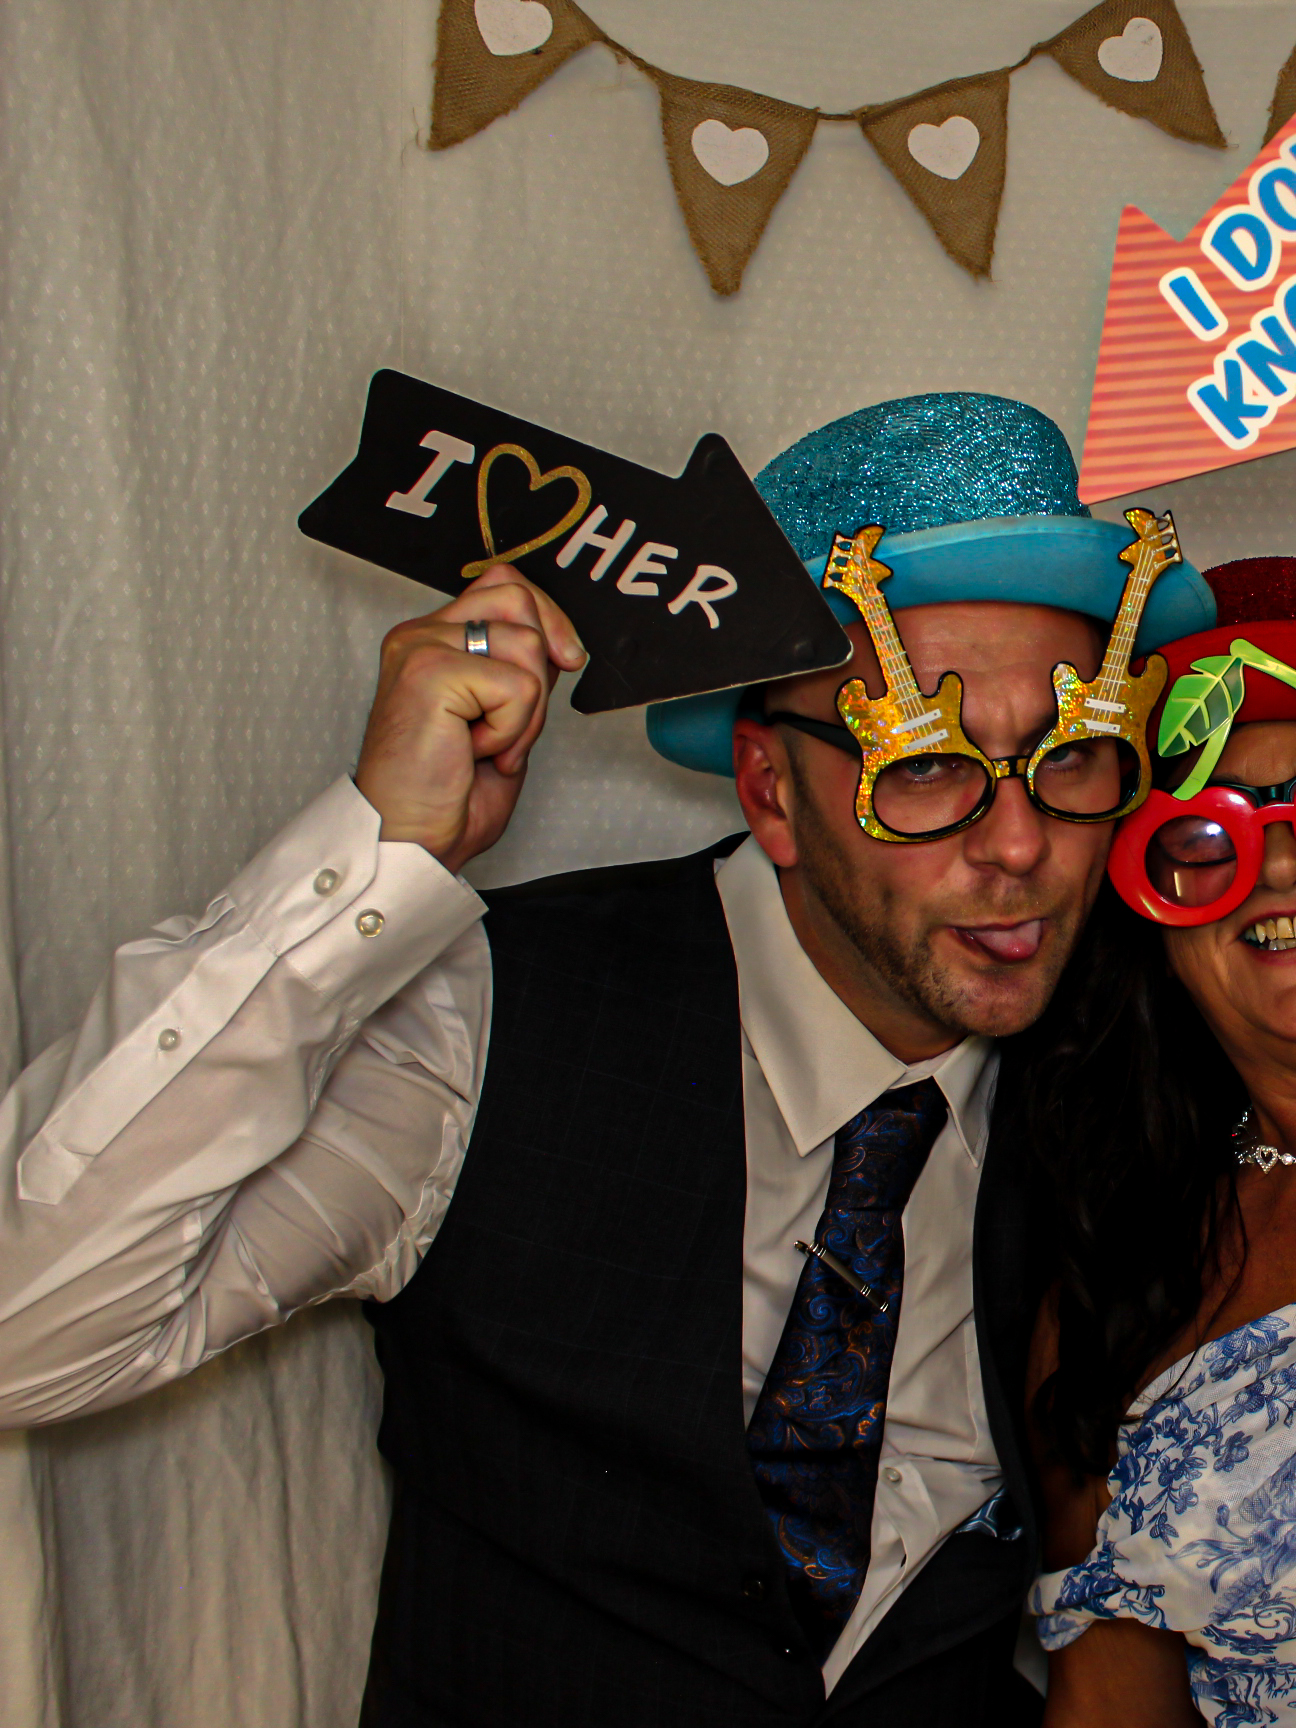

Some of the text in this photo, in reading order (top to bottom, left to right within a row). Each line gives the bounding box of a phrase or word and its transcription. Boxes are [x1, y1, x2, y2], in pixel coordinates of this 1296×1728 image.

[1166, 273, 1222, 334] I
[385, 429, 739, 631] I HER
